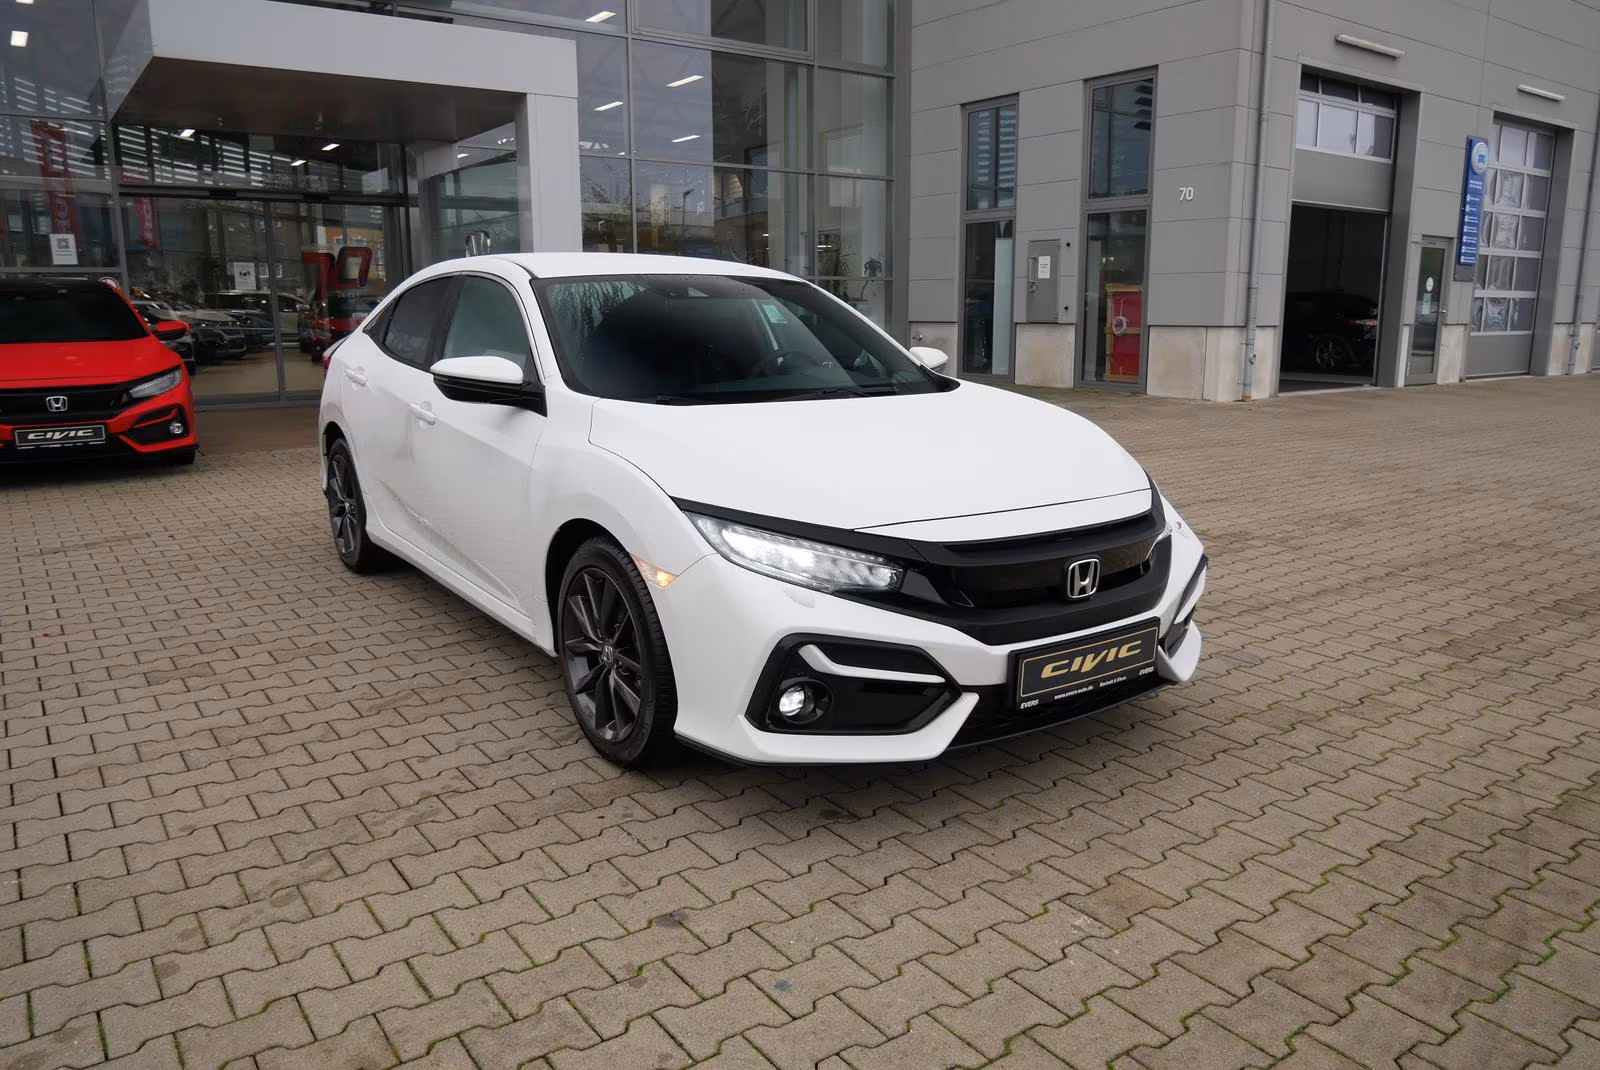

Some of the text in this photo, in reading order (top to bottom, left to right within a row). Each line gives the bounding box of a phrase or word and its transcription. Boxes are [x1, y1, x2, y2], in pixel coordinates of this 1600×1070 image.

[1179, 187, 1194, 201] 70
[27, 429, 94, 440] CIVIC
[1041, 640, 1142, 679] CIVIC
[1139, 666, 1154, 675] EVERS
[1020, 699, 1039, 709] EVERS
